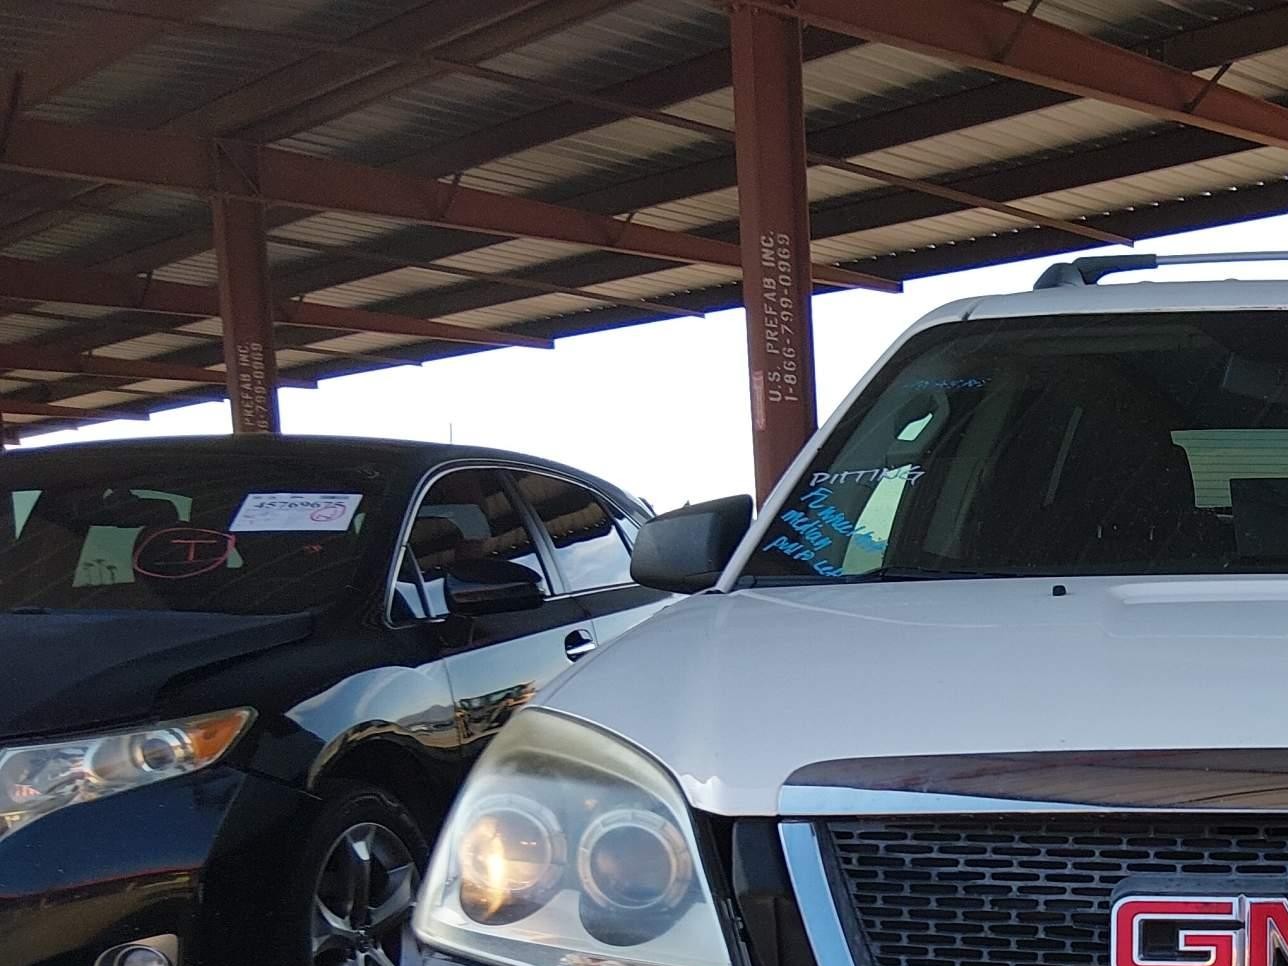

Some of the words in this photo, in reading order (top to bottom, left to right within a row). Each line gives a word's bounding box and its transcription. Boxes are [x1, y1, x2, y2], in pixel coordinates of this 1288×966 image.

[759, 230, 777, 268] INC.
[762, 277, 781, 354] PREFAB
[777, 233, 799, 402] 1-866-799-0969
[767, 366, 783, 403] U.S.
